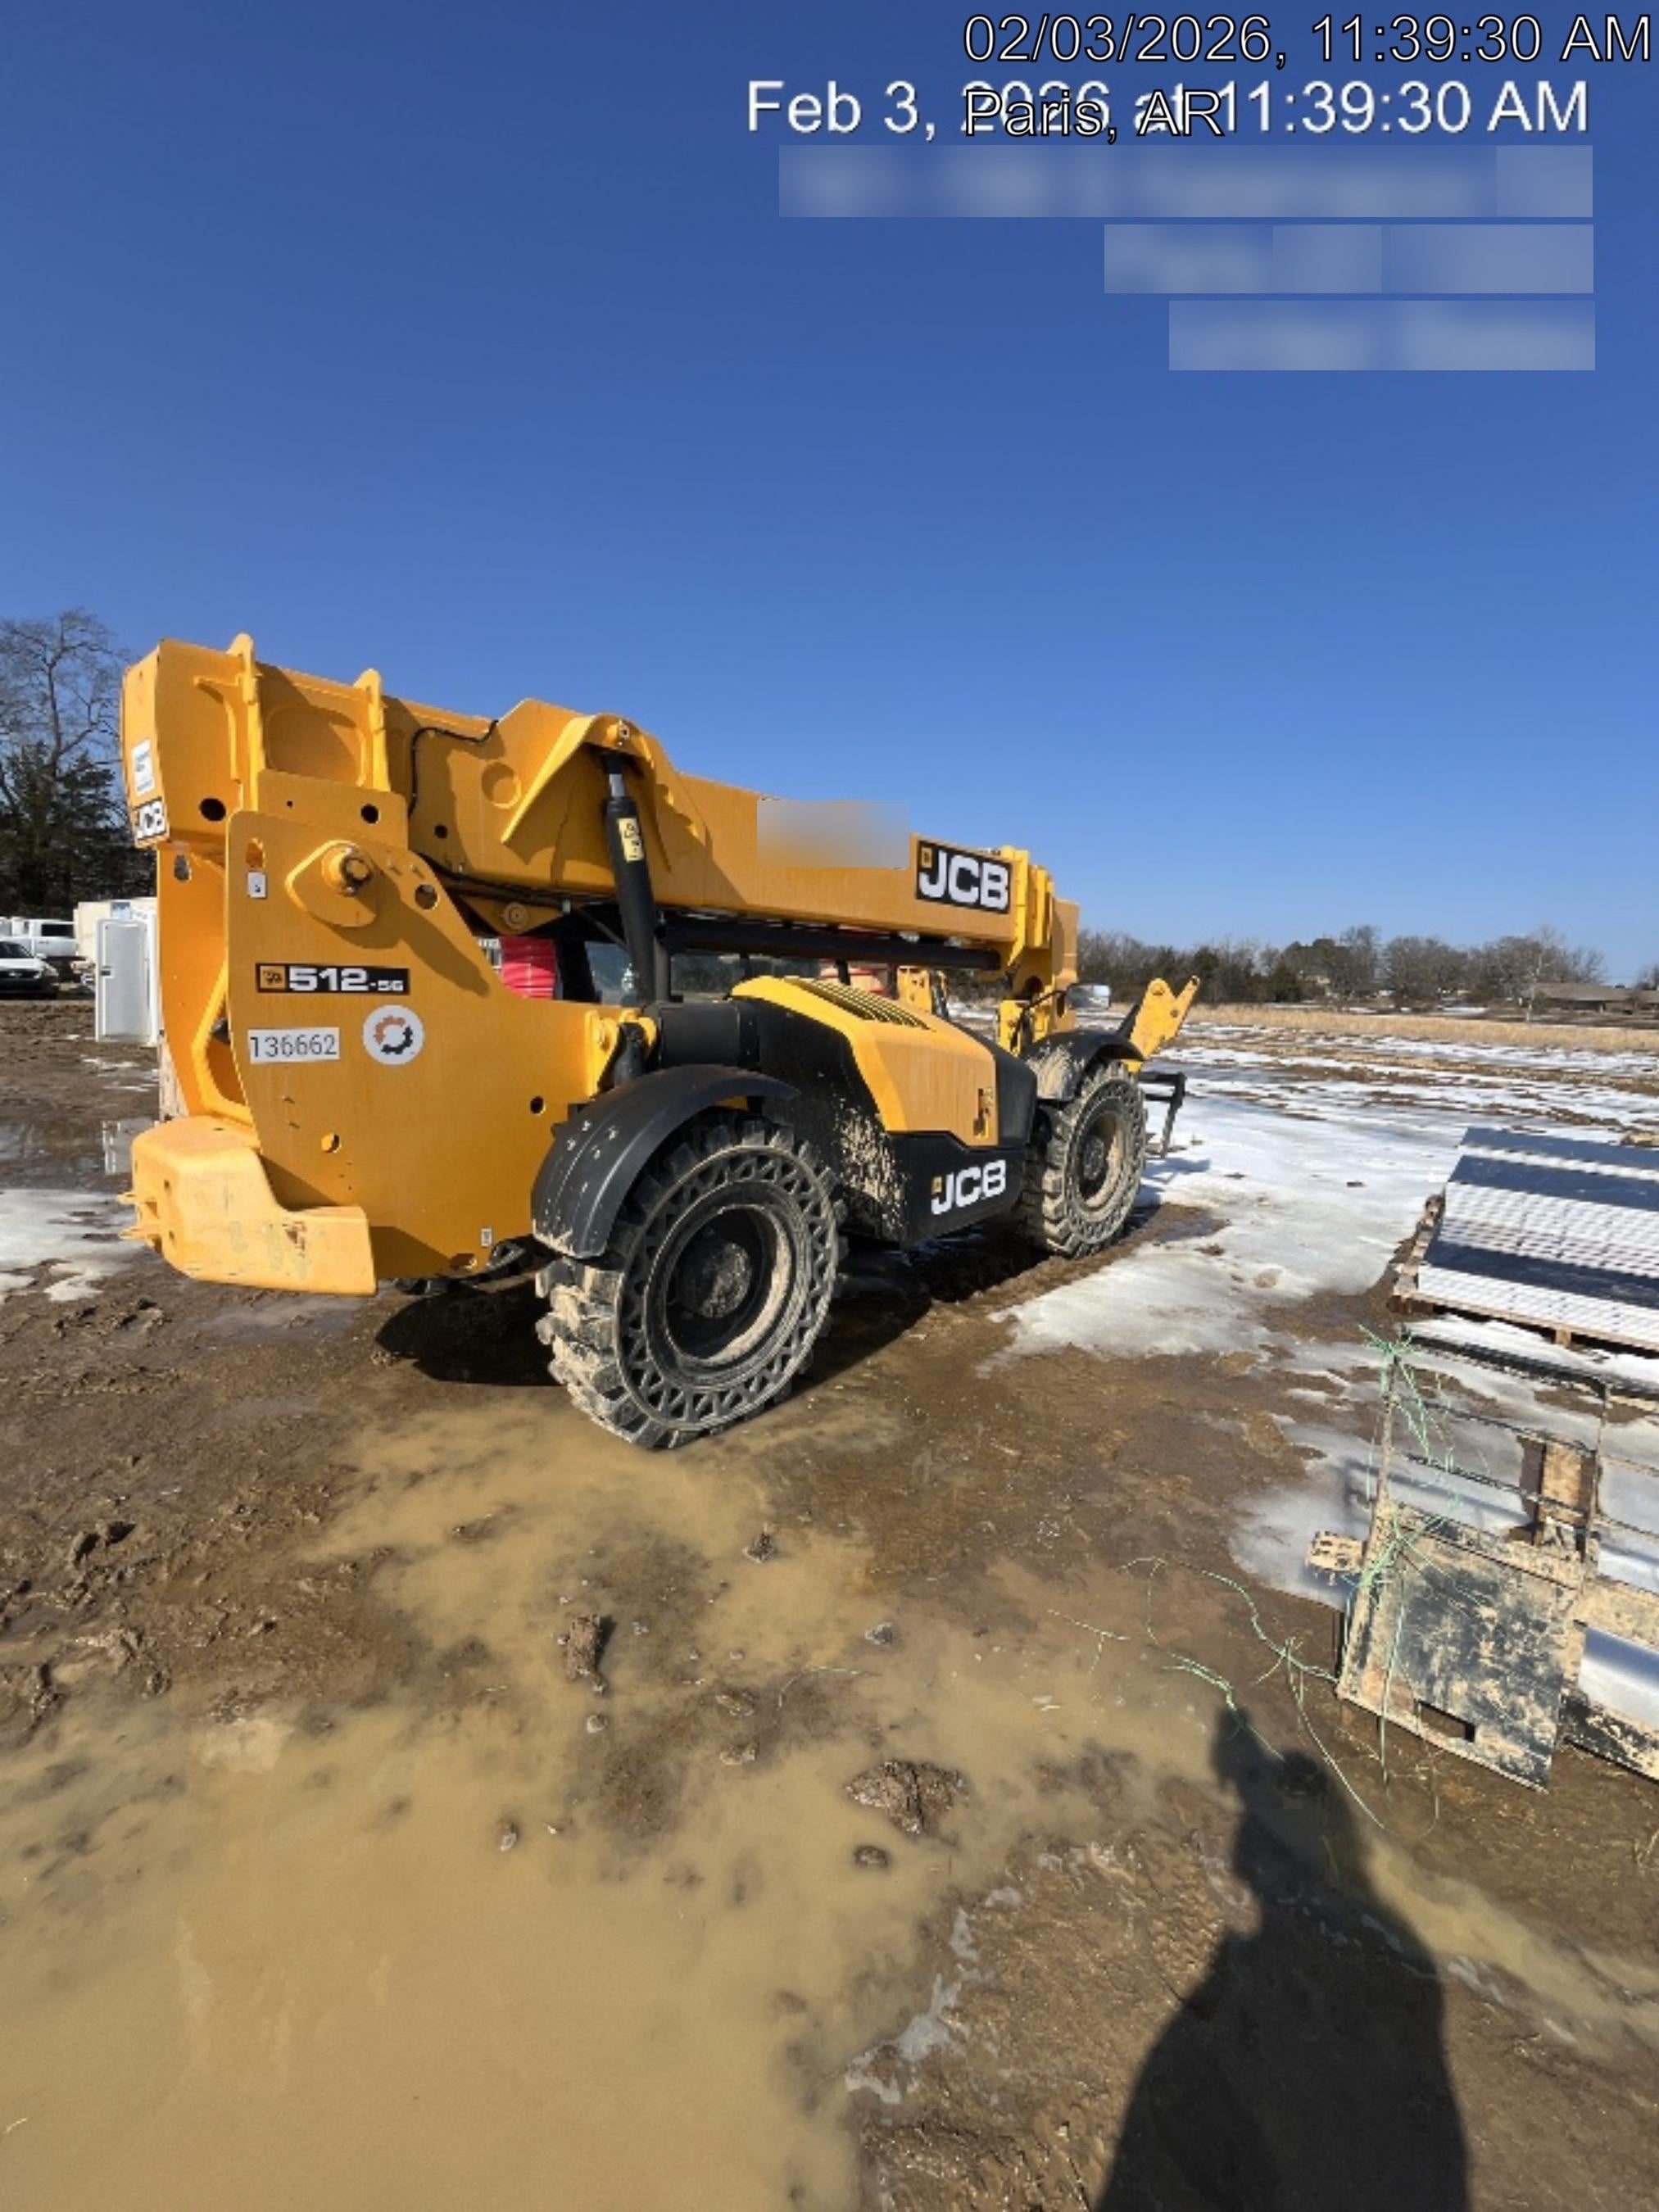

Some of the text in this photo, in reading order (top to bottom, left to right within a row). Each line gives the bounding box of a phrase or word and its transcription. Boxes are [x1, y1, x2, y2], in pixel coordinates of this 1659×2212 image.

[918, 849, 1009, 910] JCB
[250, 1034, 337, 1058] 136662
[931, 1159, 1007, 1216] JCB
